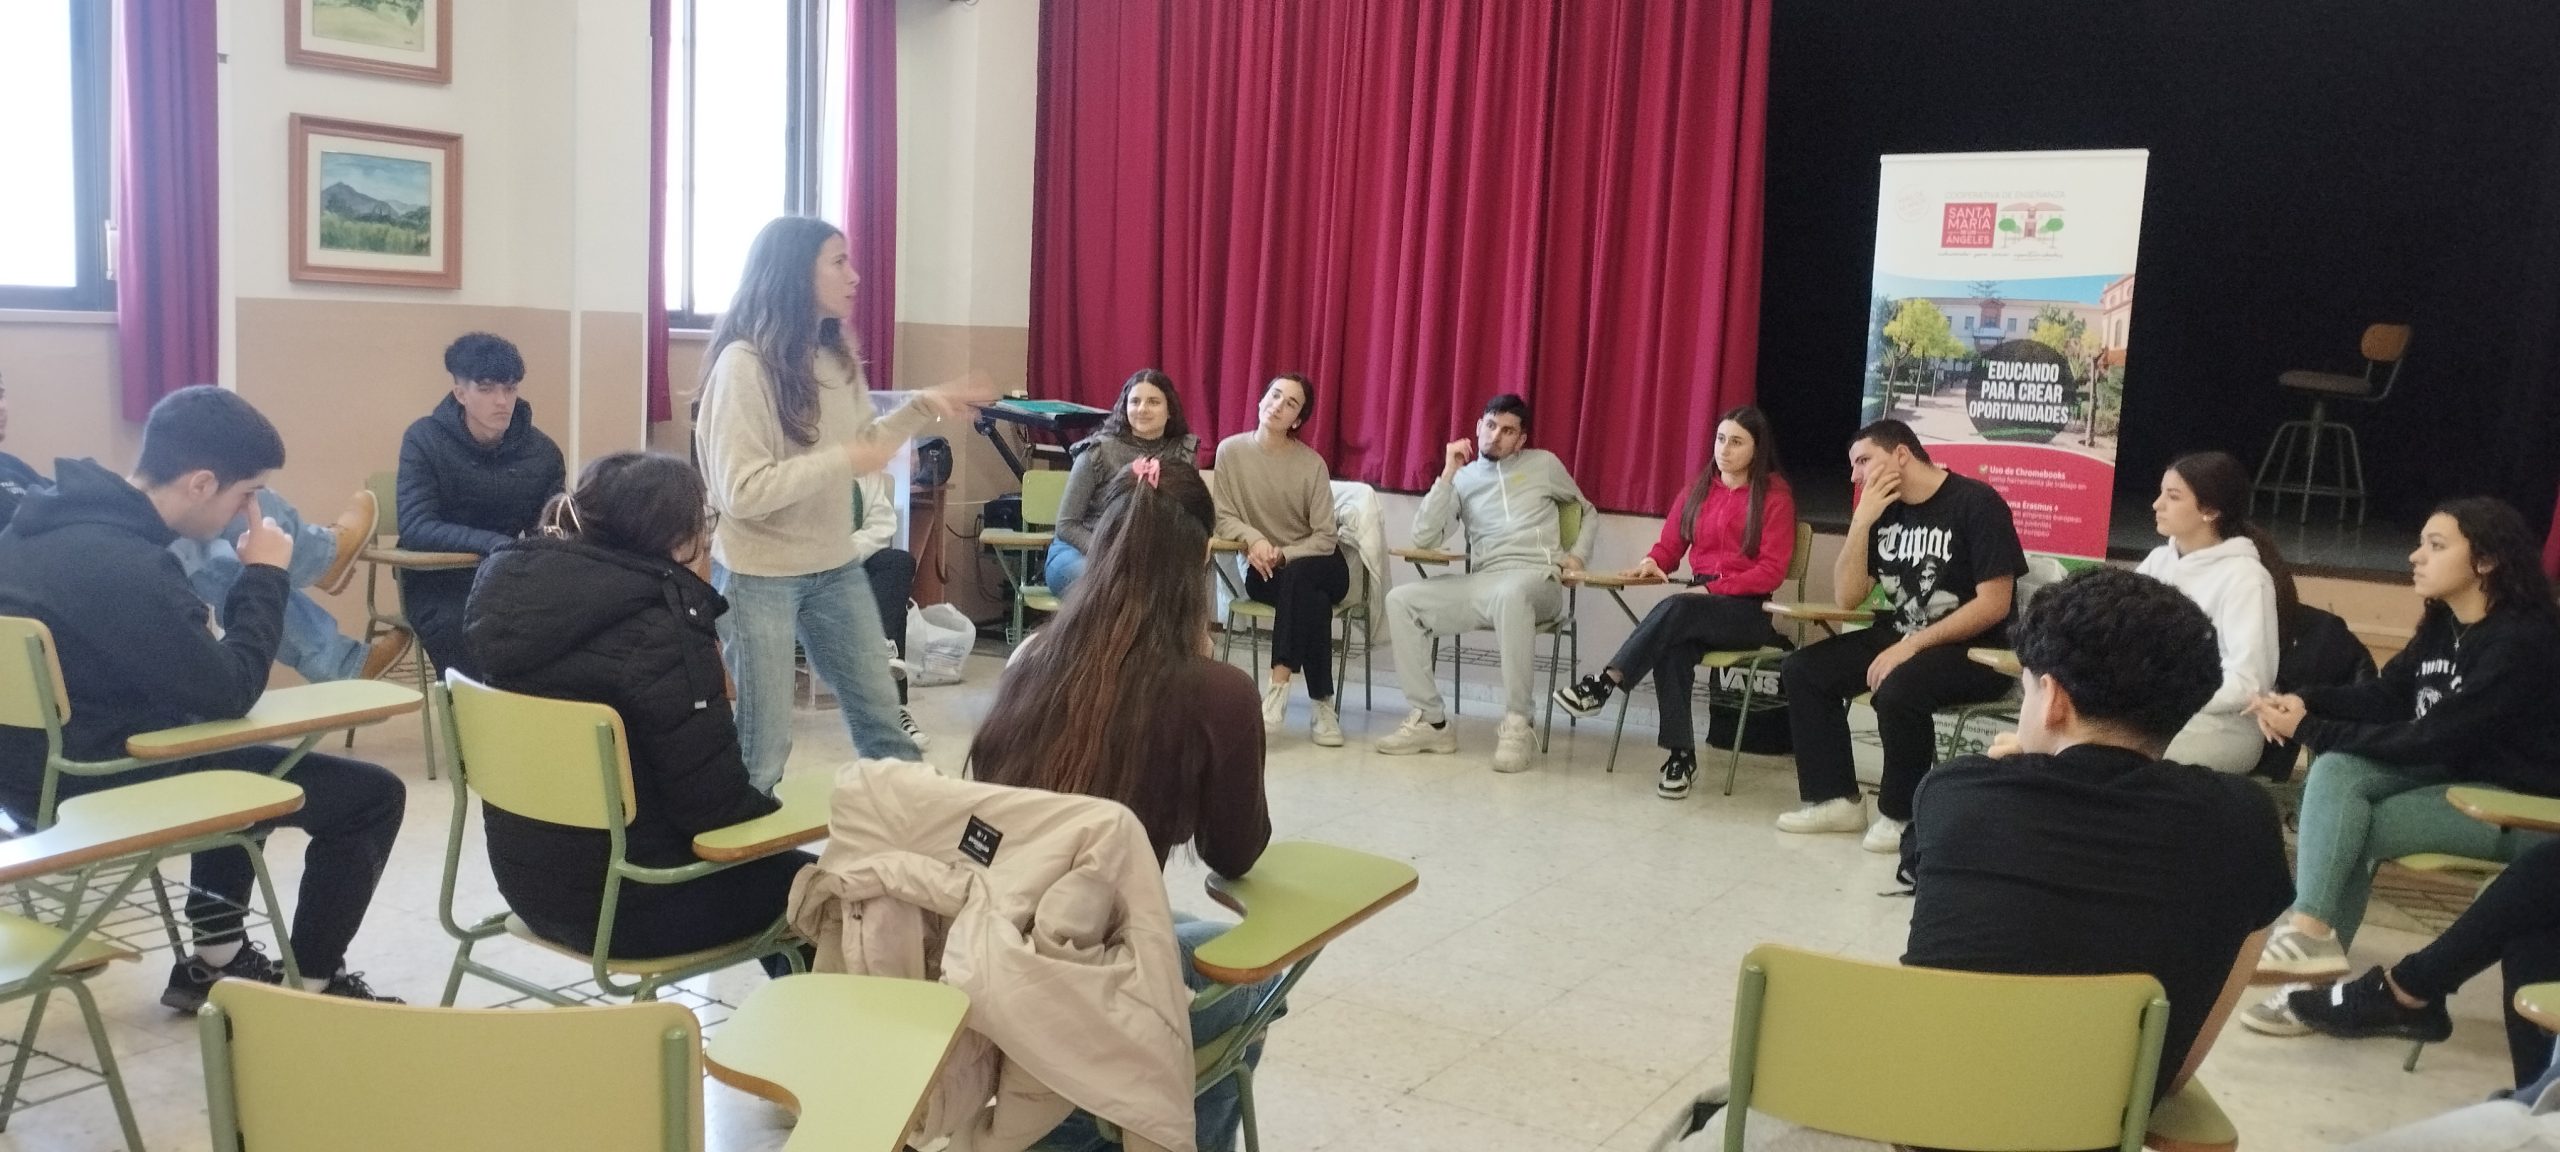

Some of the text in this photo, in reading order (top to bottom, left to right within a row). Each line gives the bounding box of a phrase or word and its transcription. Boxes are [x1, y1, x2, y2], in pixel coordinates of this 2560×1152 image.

[1948, 207, 1991, 219] SANTA
[1981, 380, 2063, 403] PARA CREAR
[1990, 466, 2066, 480] Uso de Chromebooks
[2023, 500, 2052, 512] Erasmus
[1878, 522, 1953, 567] Tupac
[1719, 666, 1781, 695] VANS
